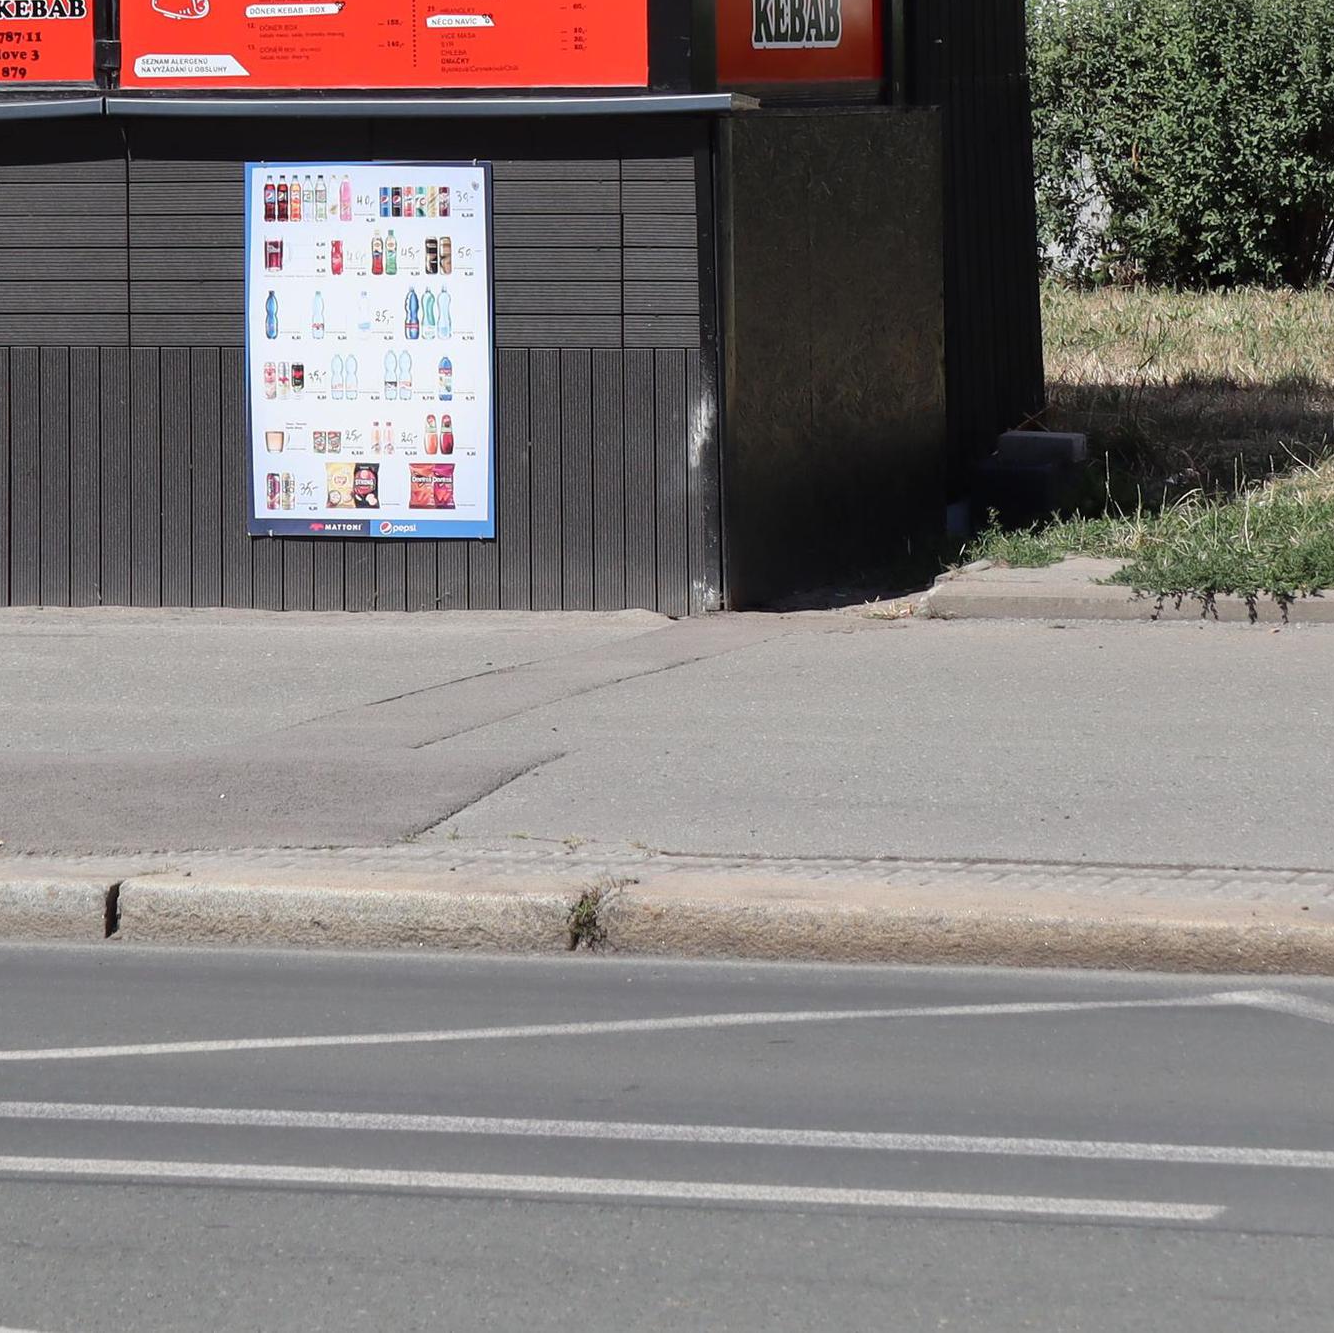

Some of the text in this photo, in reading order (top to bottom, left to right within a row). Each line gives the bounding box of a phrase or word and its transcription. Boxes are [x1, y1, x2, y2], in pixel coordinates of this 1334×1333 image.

[250, 6, 276, 14] DÖNER
[30, 50, 40, 61] 3
[2, 67, 27, 79] 879
[324, 523, 362, 531] MATTONI
[392, 524, 417, 533] pepsi
